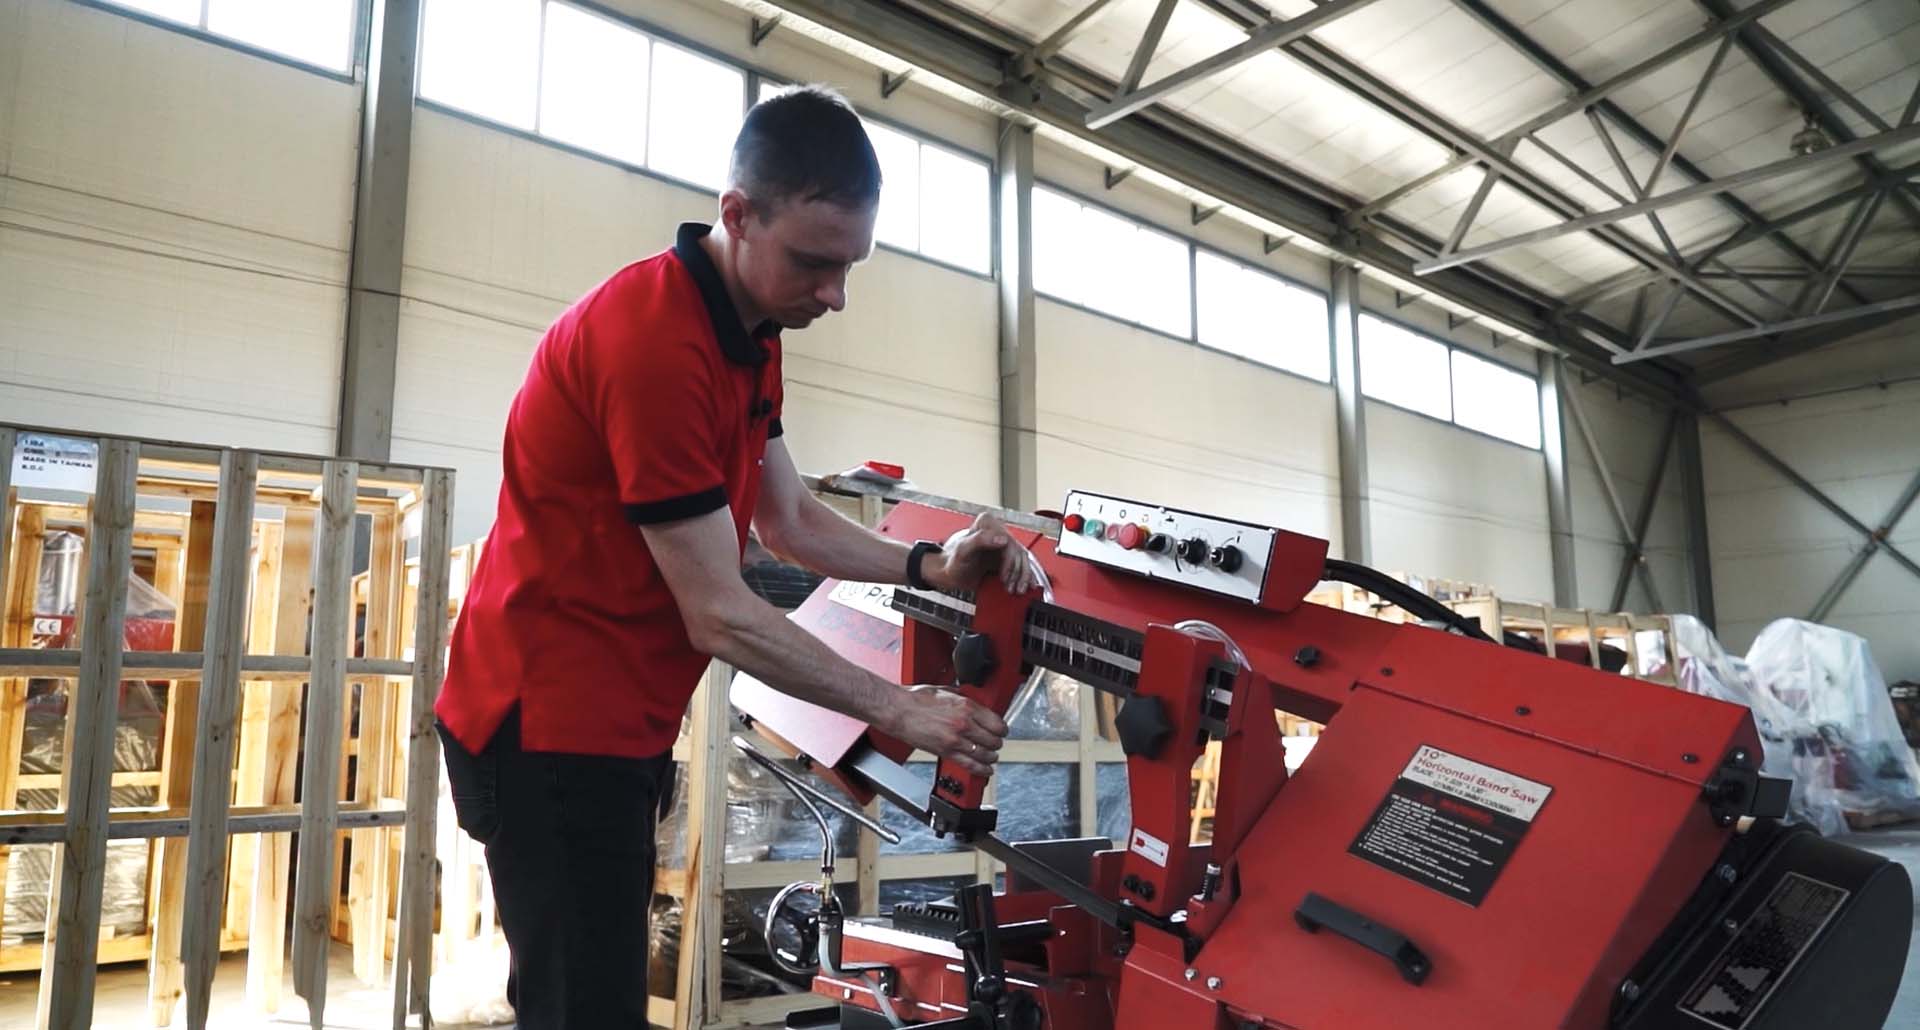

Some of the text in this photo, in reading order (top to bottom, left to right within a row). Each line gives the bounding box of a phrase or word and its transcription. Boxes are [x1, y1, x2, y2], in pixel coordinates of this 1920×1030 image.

[864, 586, 894, 608] Pro
[1418, 757, 1476, 782] Horizontal
[1477, 776, 1509, 795] Band
[1510, 786, 1539, 805] Saw
